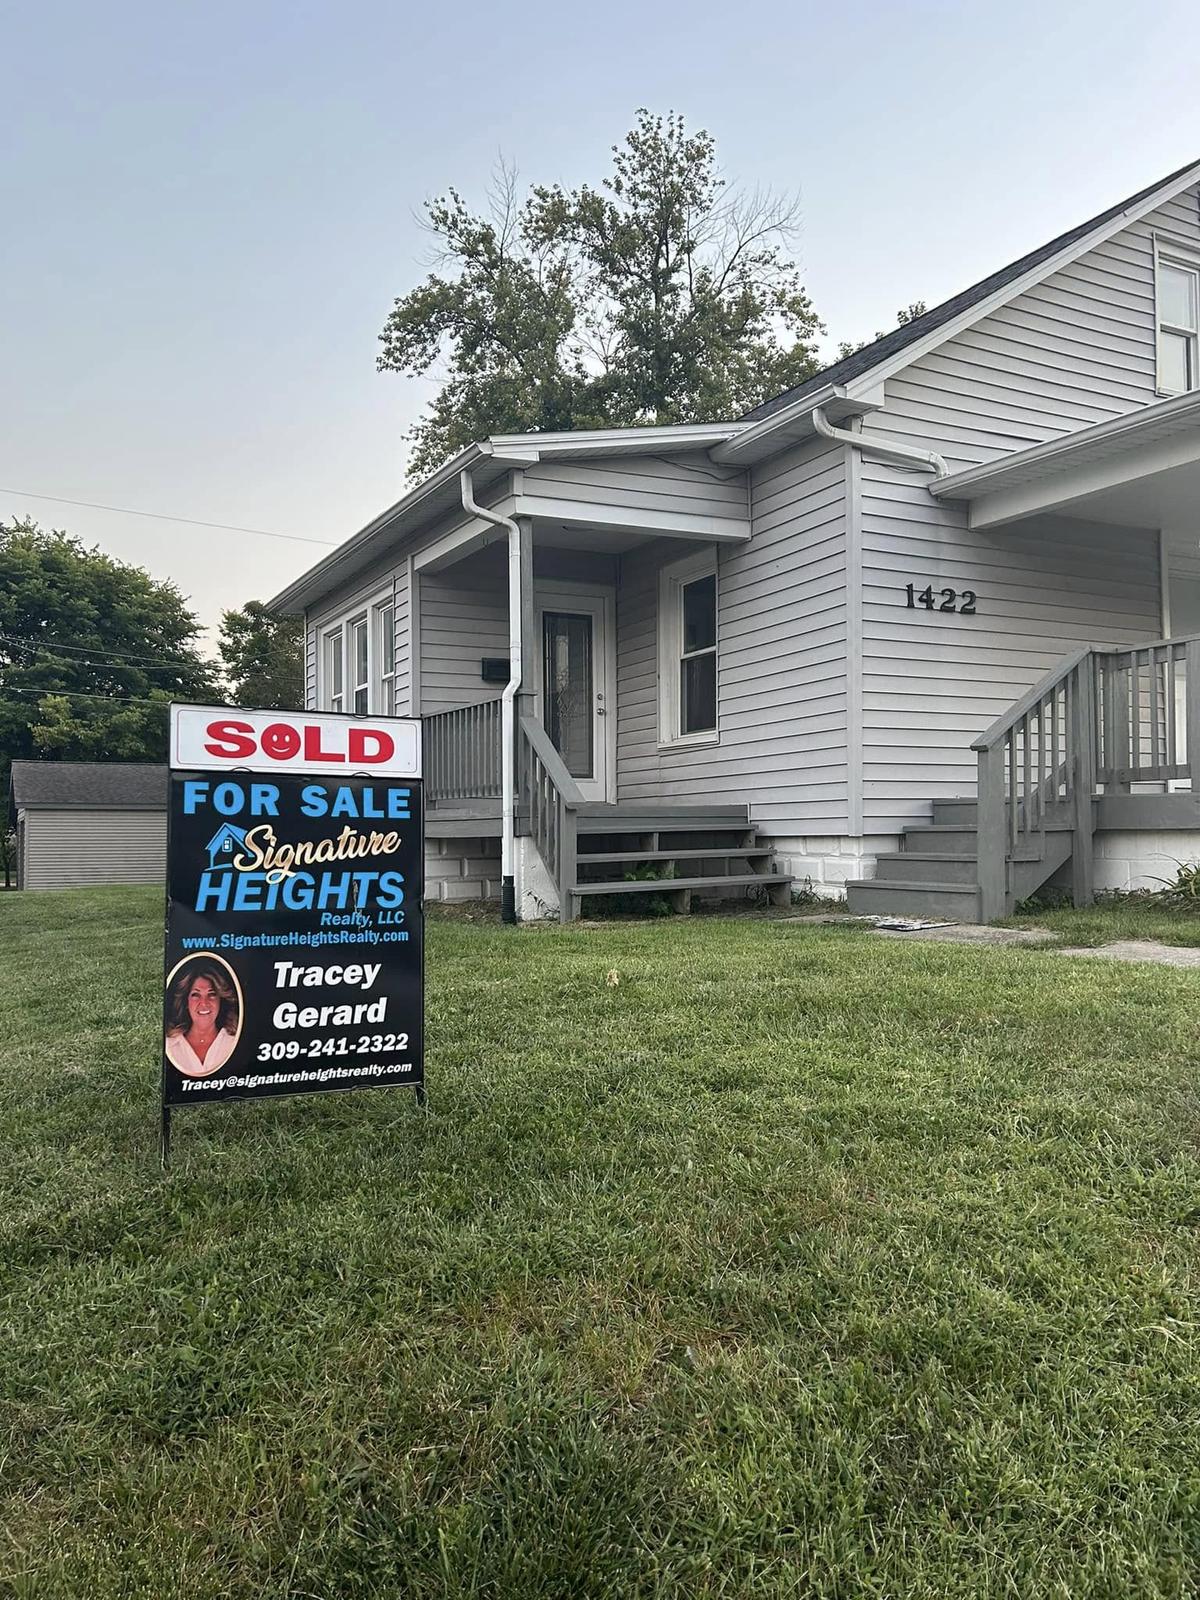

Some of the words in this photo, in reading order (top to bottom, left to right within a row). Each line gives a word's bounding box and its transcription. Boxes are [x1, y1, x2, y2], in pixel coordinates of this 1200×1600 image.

[906, 583, 976, 614] 1422
[204, 720, 395, 764] SOLD
[183, 781, 280, 816] FOR
[300, 785, 411, 819] SALE
[233, 824, 402, 885] Signature
[195, 871, 405, 912] HEIGHTS
[320, 912, 373, 927] Realty,
[377, 911, 405, 925] LLC
[182, 930, 409, 950] www.SignatureHeightsRealty.com
[273, 961, 382, 990] Tracey
[272, 997, 388, 1030] Gerard
[256, 1033, 409, 1061] 309-241-2322
[181, 1062, 412, 1092] Tracey@signatureheightsrealty.com
